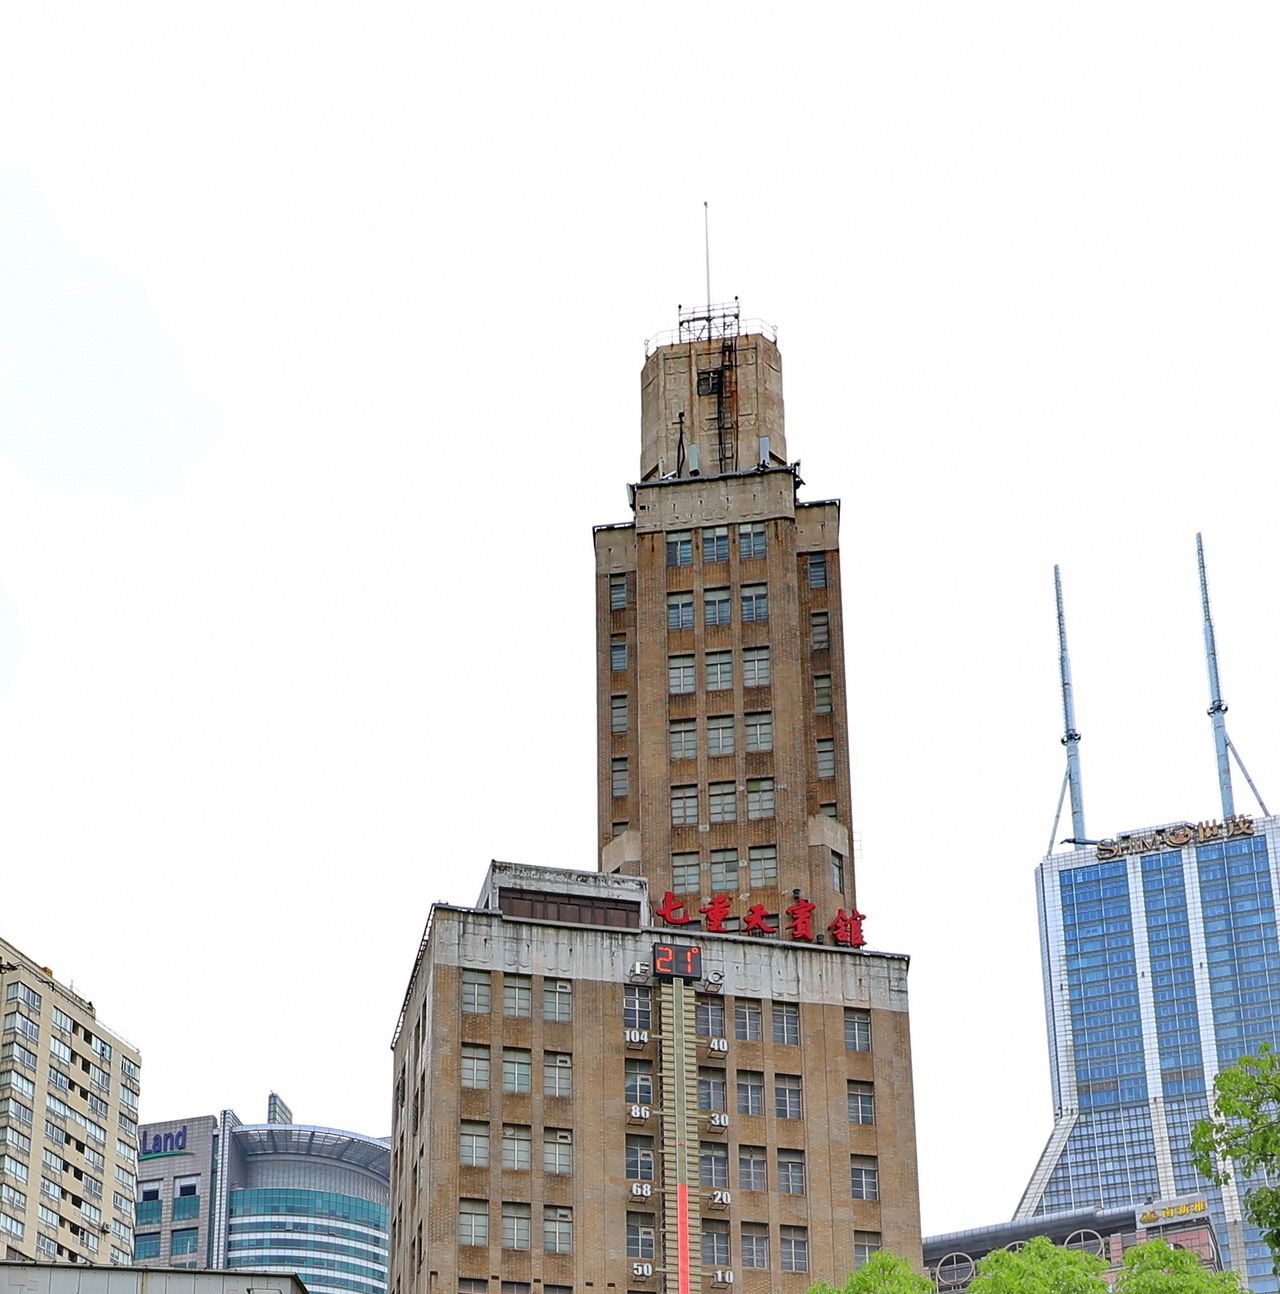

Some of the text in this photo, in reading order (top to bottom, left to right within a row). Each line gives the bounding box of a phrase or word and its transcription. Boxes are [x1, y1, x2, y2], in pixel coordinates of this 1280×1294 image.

[635, 961, 650, 975] F
[708, 970, 724, 984] C
[624, 1029, 649, 1043] 104
[710, 1039, 728, 1051] 40
[631, 1105, 650, 1119] 86
[711, 1112, 729, 1126] 30
[632, 1183, 652, 1197] 68
[713, 1191, 731, 1204] 20
[633, 1263, 652, 1277] 50
[716, 1270, 734, 1283] 10
